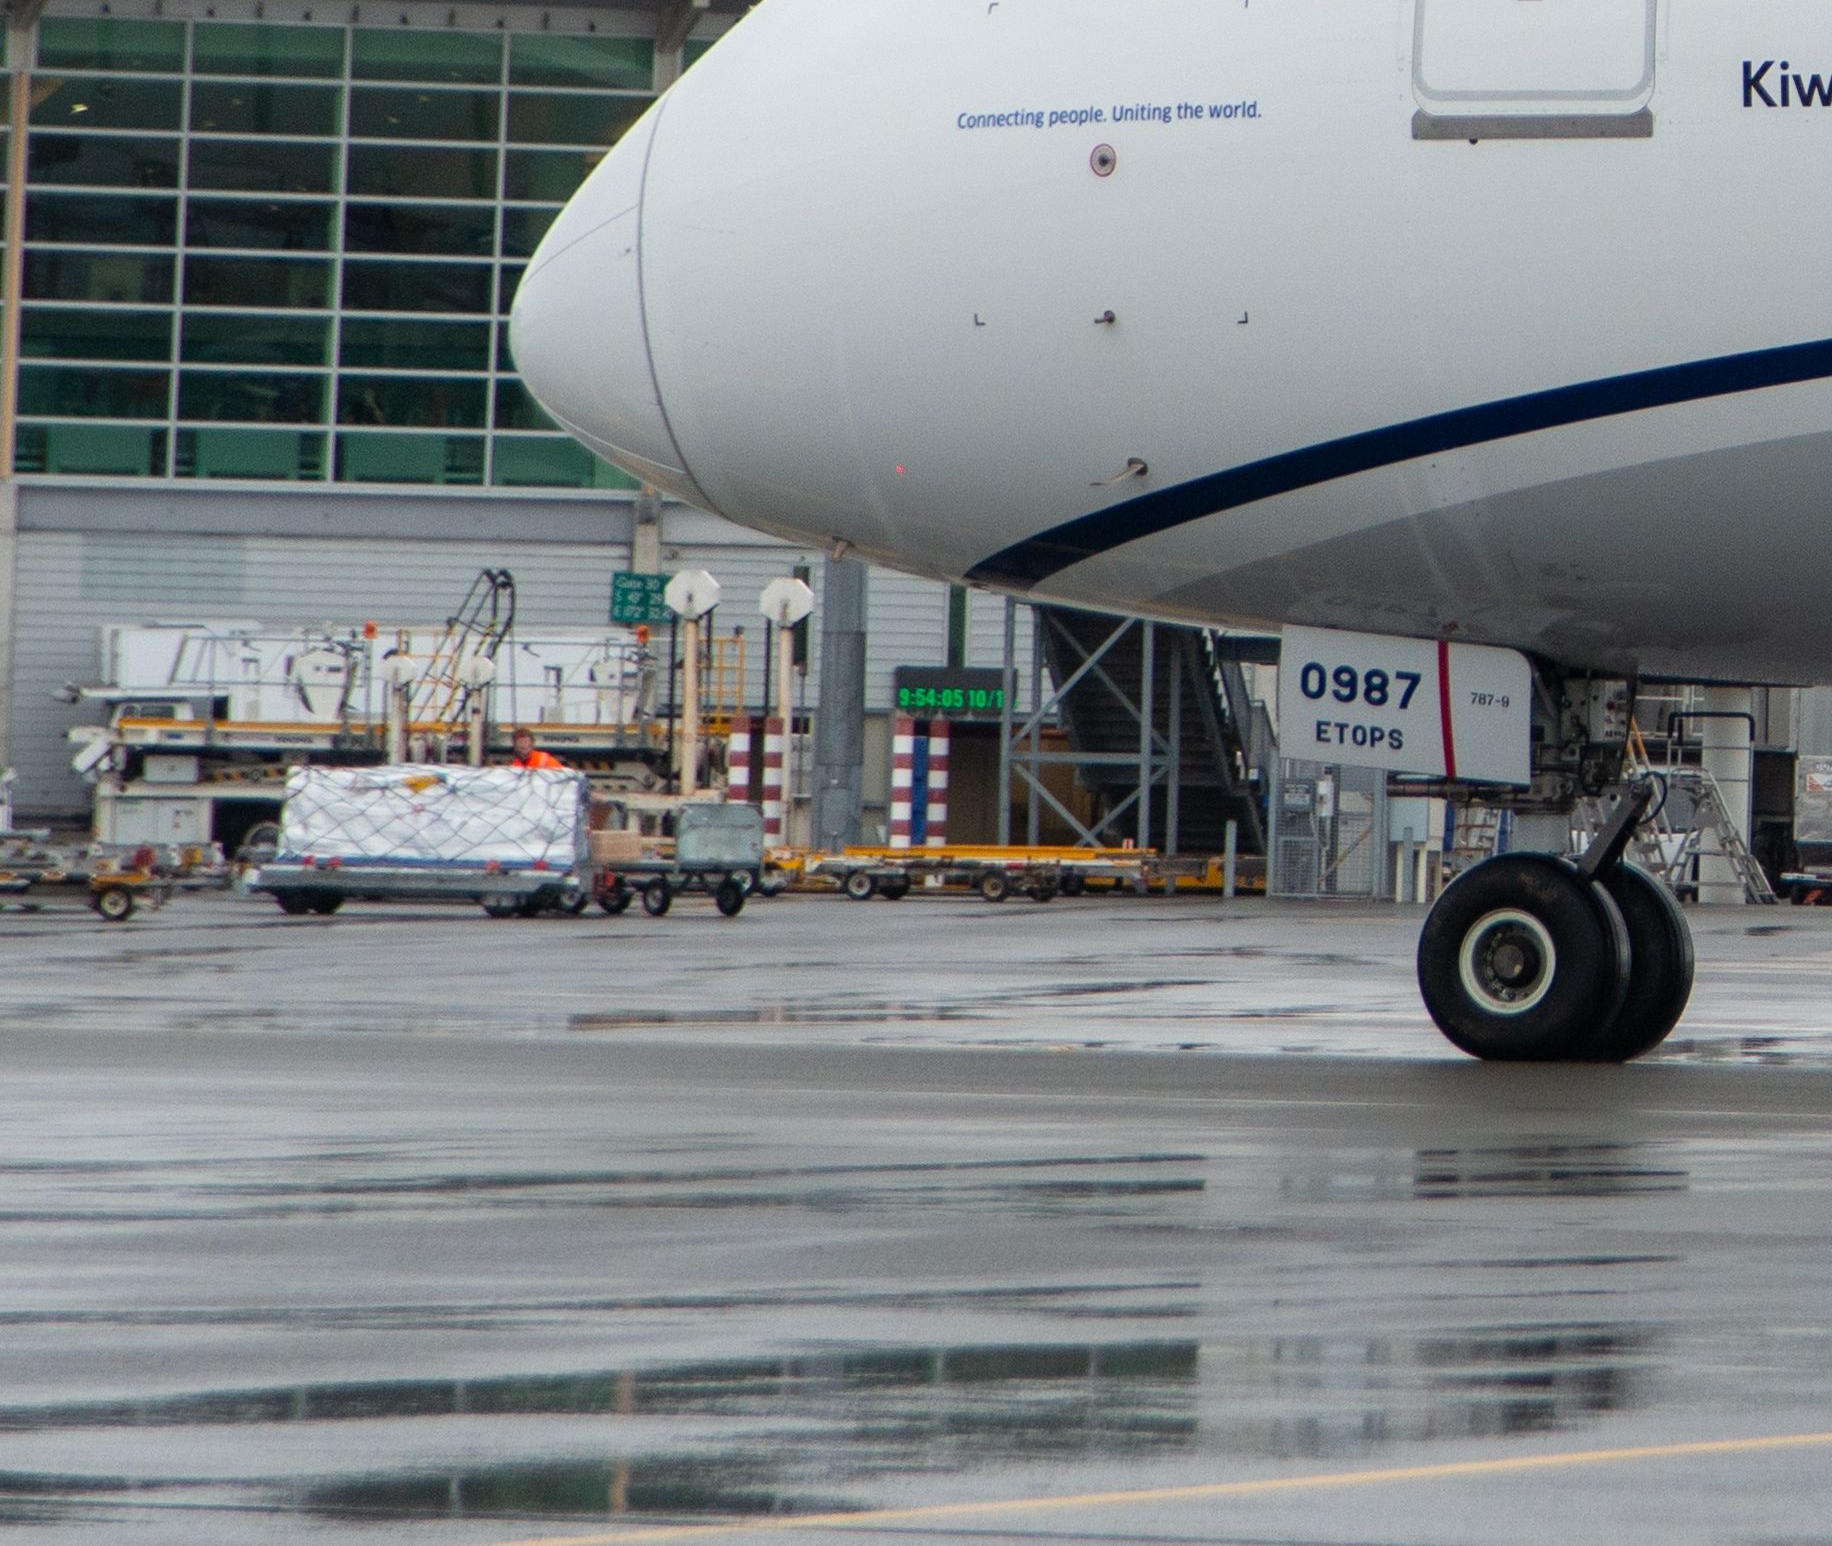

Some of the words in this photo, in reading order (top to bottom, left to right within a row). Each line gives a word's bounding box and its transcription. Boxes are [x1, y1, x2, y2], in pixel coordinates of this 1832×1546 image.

[957, 108, 1044, 129] Connecting
[1049, 105, 1107, 127] people.
[1112, 102, 1172, 123] Uniting
[1176, 101, 1204, 120] the
[1209, 100, 1262, 119] world.
[898, 688, 964, 708] 9:54:05
[1301, 661, 1421, 710] 0987
[1470, 692, 1510, 708] 787-9
[1316, 720, 1404, 750] ETOPS
